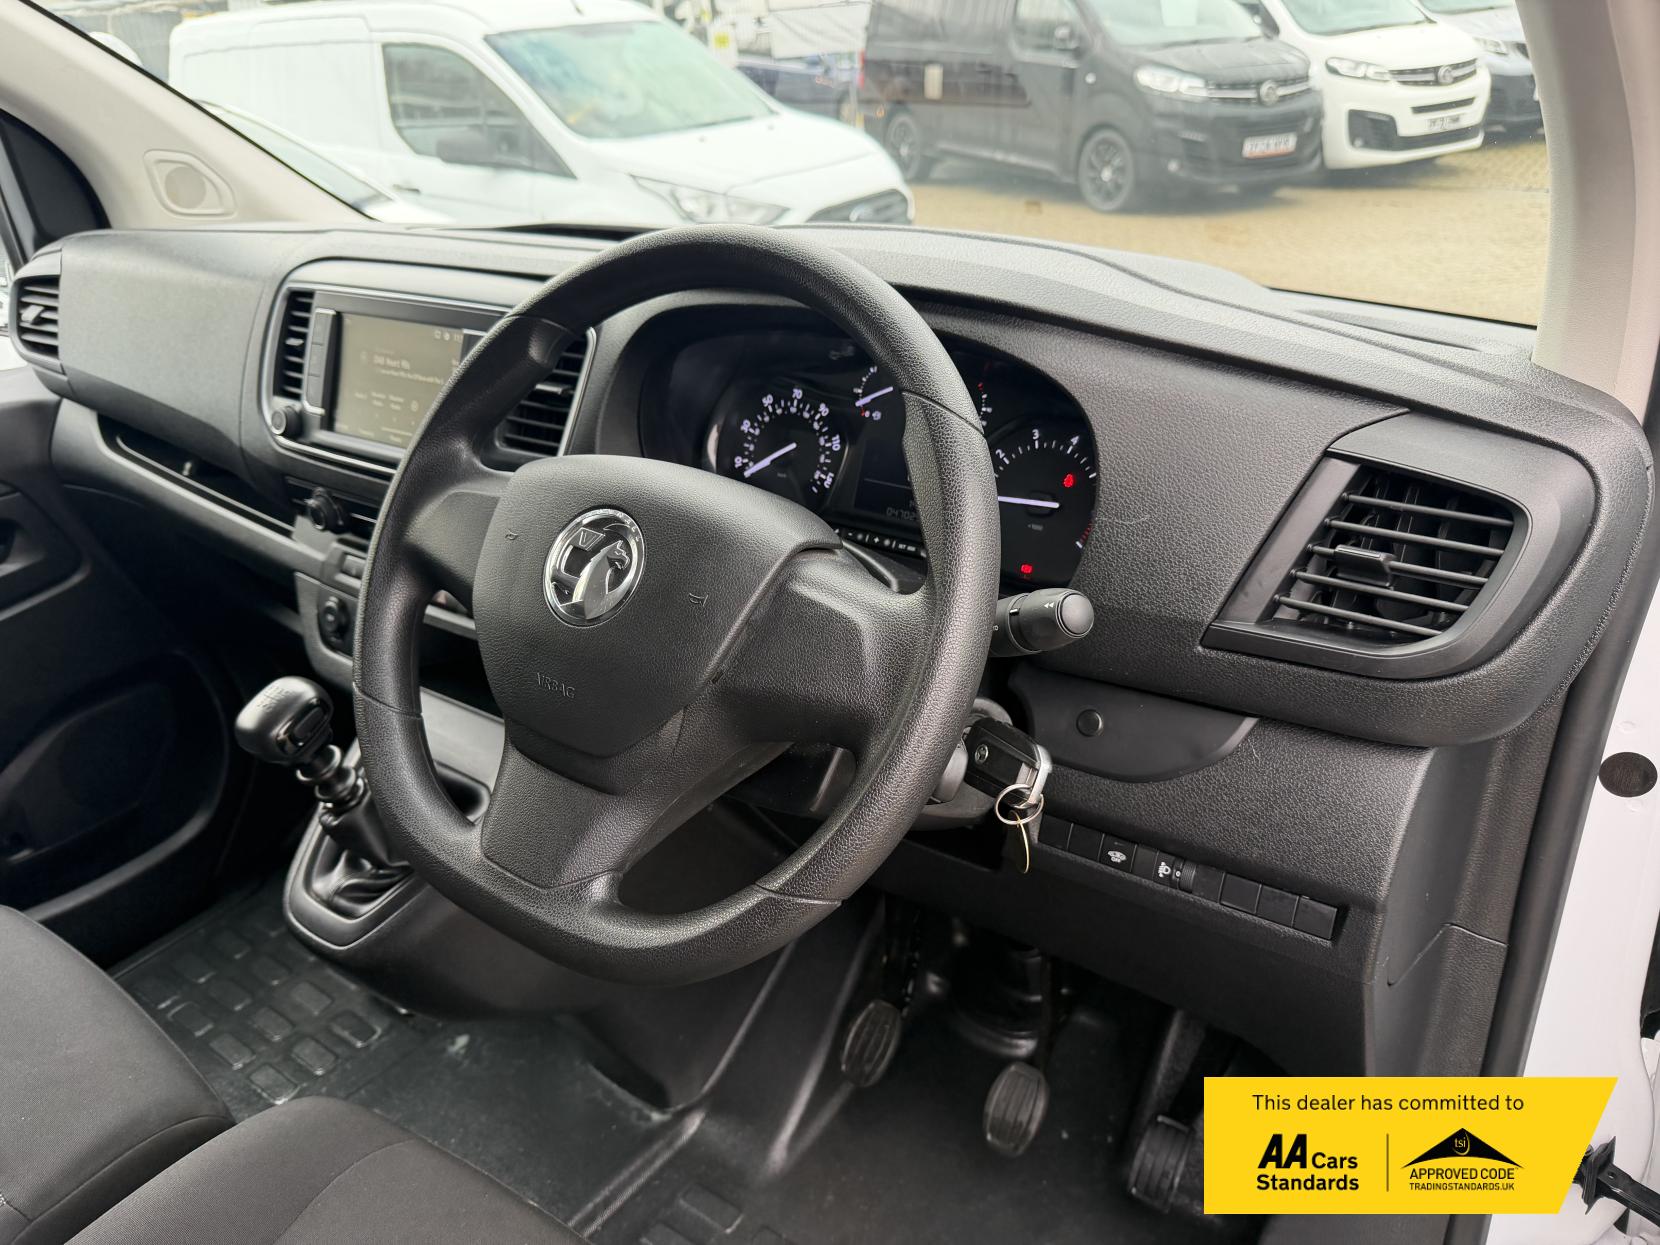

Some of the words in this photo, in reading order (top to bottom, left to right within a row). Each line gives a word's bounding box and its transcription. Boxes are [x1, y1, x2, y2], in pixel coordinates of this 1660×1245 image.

[792, 388, 803, 400] 70
[818, 403, 830, 417] 90
[1031, 428, 1040, 440] 3
[831, 433, 842, 452] 110
[1070, 435, 1080, 446] 4
[995, 449, 1006, 459] 2
[734, 455, 743, 469] 10
